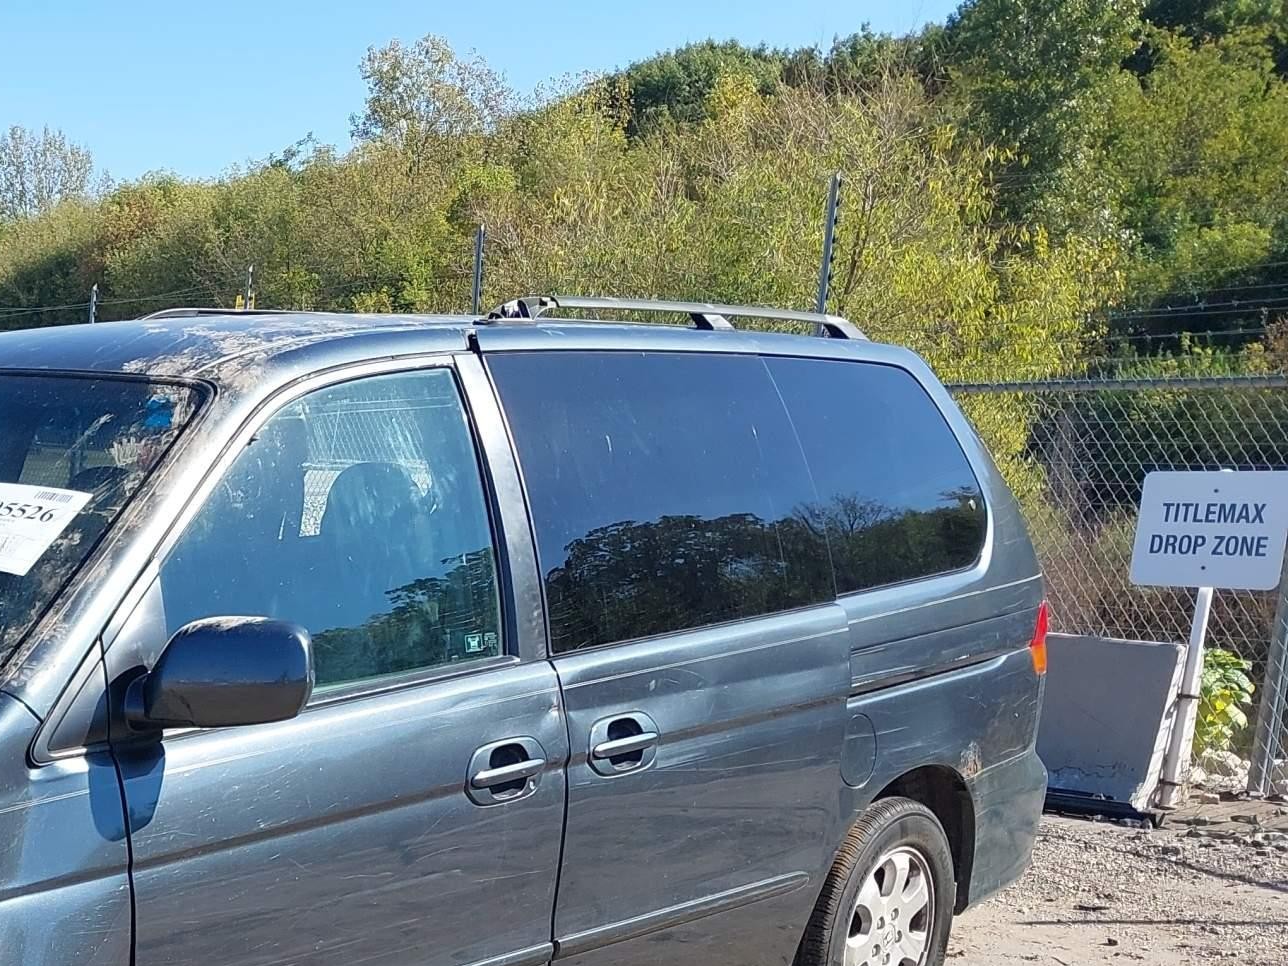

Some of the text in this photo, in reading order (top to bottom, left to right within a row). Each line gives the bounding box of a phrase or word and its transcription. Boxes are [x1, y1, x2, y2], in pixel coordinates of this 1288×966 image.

[1162, 502, 1267, 523] TITLEMAX
[1149, 534, 1269, 557] DROP ZONE
